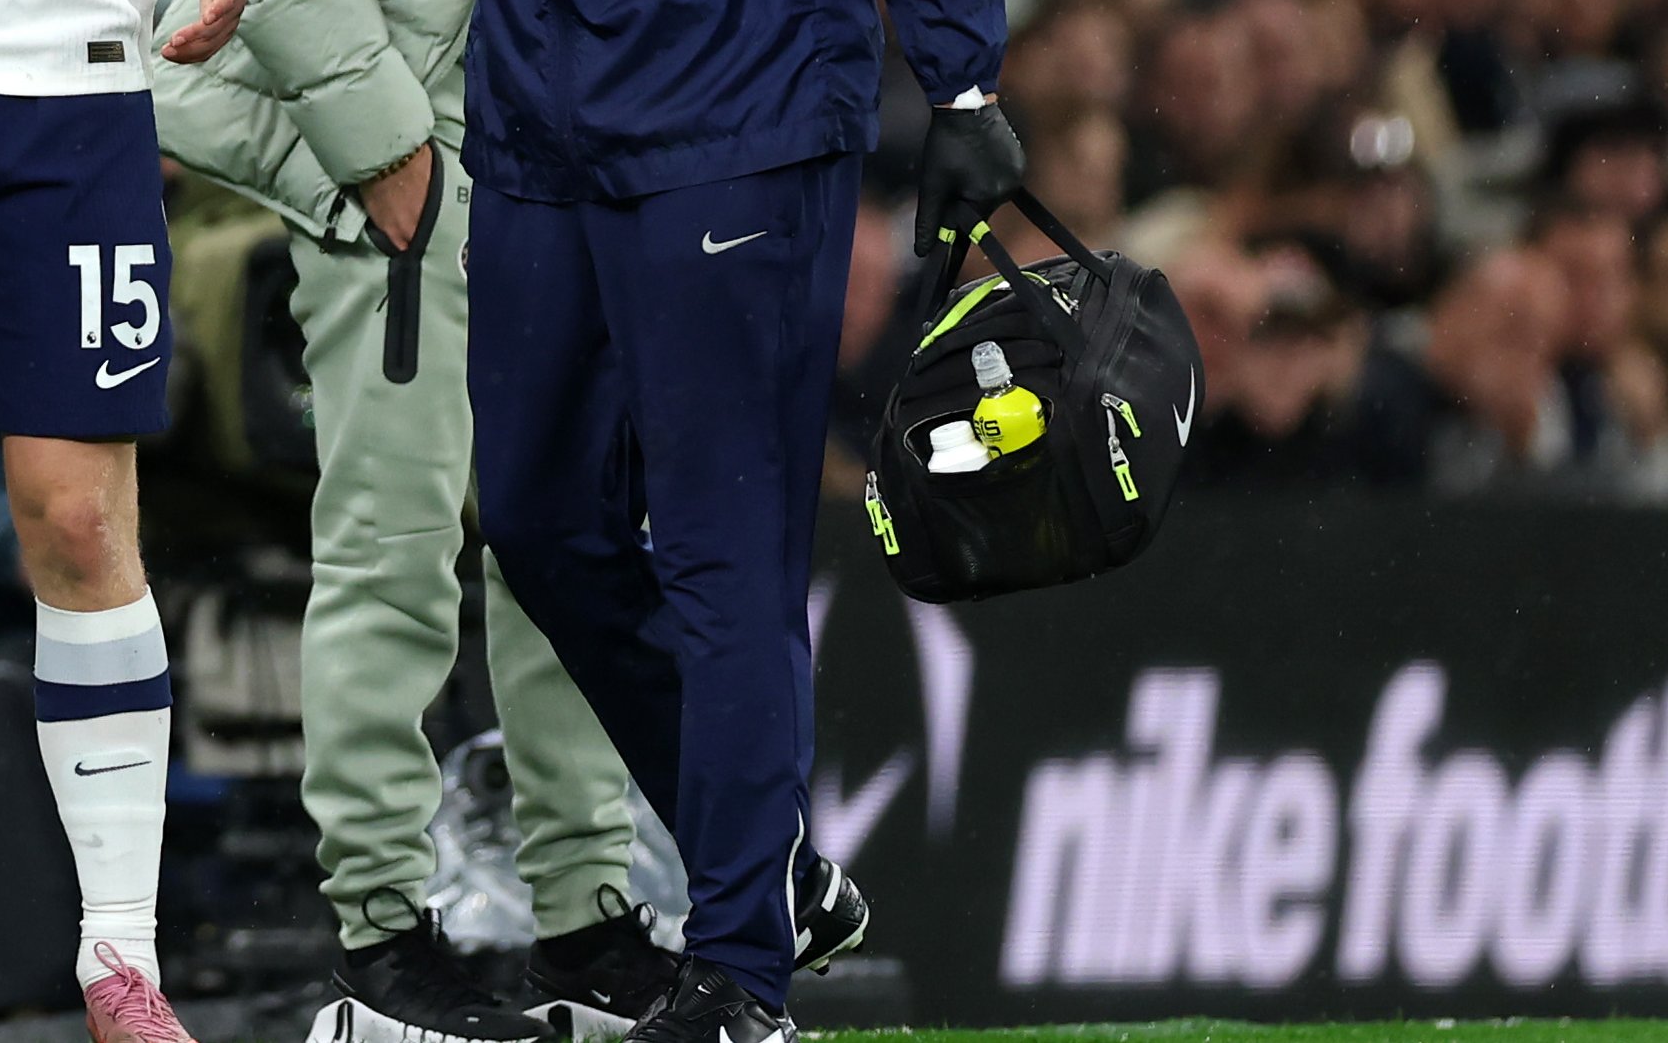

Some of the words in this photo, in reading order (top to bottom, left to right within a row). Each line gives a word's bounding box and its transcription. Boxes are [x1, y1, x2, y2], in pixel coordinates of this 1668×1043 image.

[68, 244, 161, 350] 15
[1000, 667, 1339, 991] nike
[1335, 660, 1668, 991] foot
